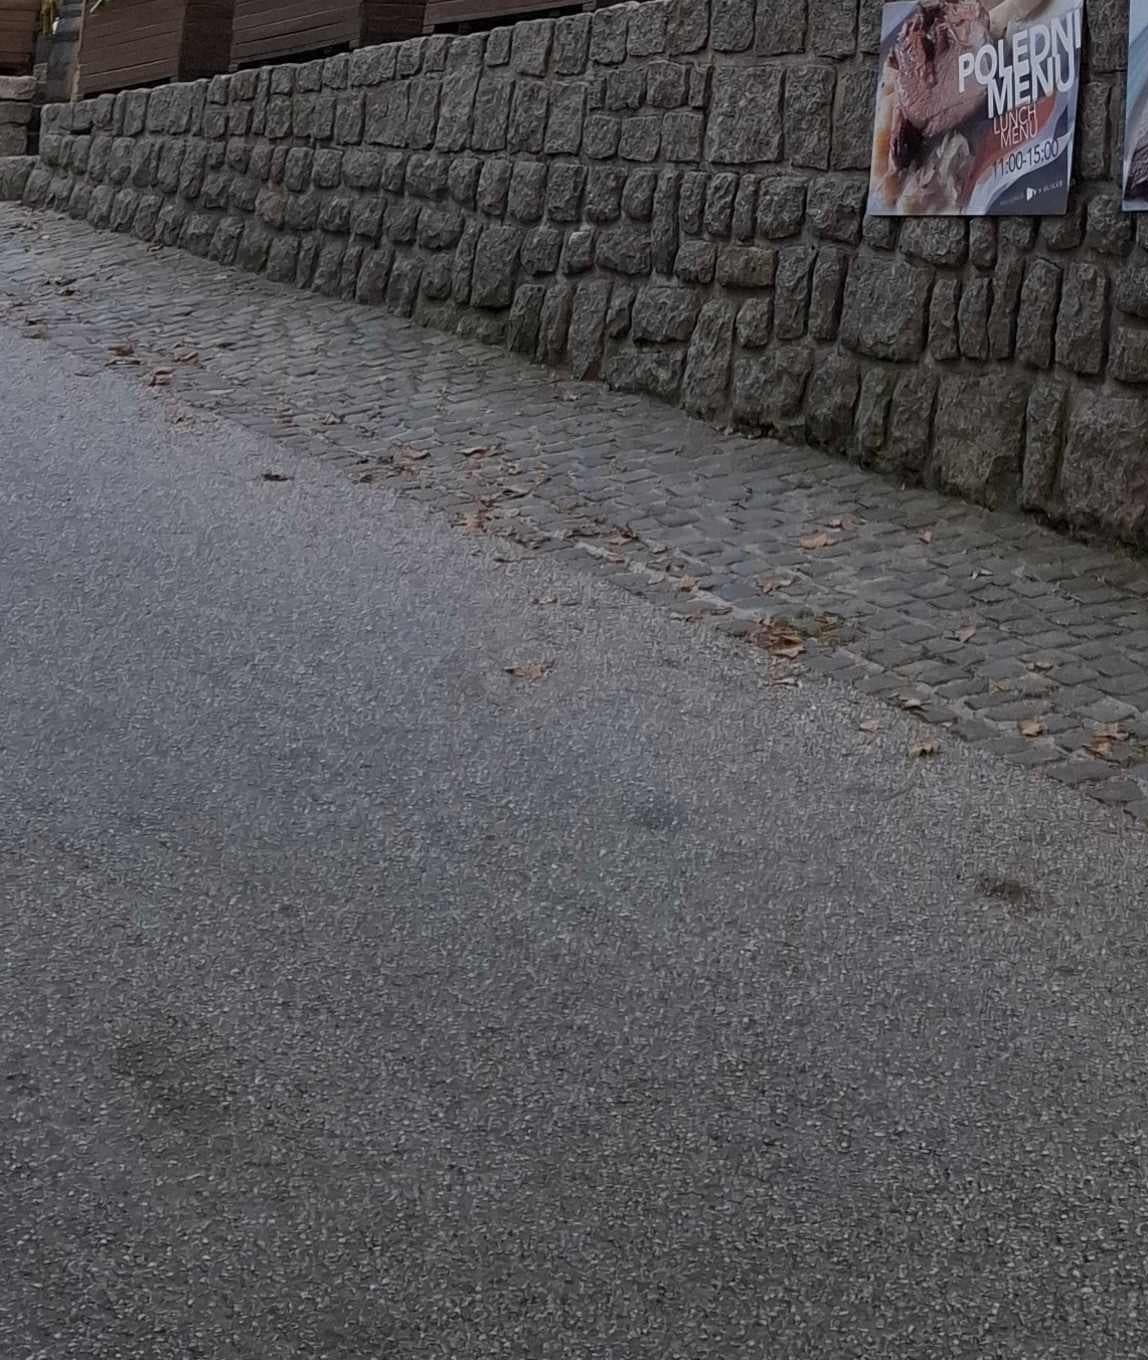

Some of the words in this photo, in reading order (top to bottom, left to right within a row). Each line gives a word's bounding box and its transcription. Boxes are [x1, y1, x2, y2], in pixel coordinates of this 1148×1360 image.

[987, 54, 1075, 119] MENU
[994, 101, 1036, 135] LUNCH
[1000, 119, 1039, 149] MENU
[993, 139, 1060, 178] 11:00-15:00
